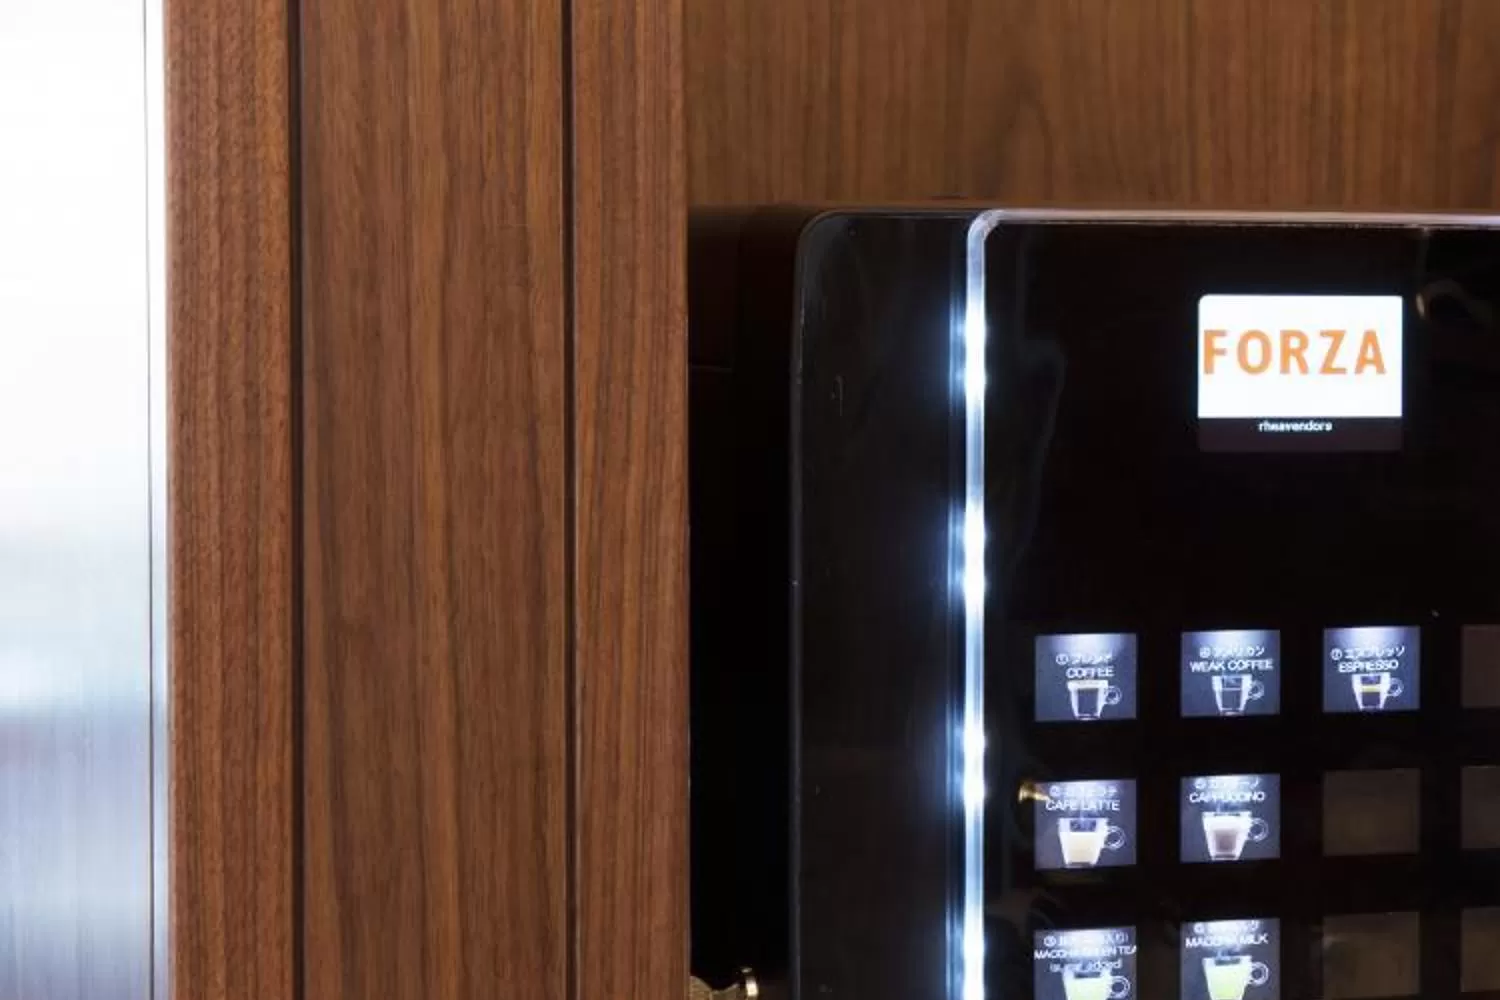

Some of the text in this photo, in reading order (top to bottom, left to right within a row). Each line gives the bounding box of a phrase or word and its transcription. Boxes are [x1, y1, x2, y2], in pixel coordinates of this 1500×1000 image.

[1203, 329, 1387, 376] FORZA
[1259, 420, 1333, 432] rheavendors
[1066, 665, 1115, 678] COFFEE
[1190, 658, 1273, 672] WEAK COFFEE
[1338, 659, 1399, 673] ESPRESSO
[1081, 798, 1120, 811] LATTE
